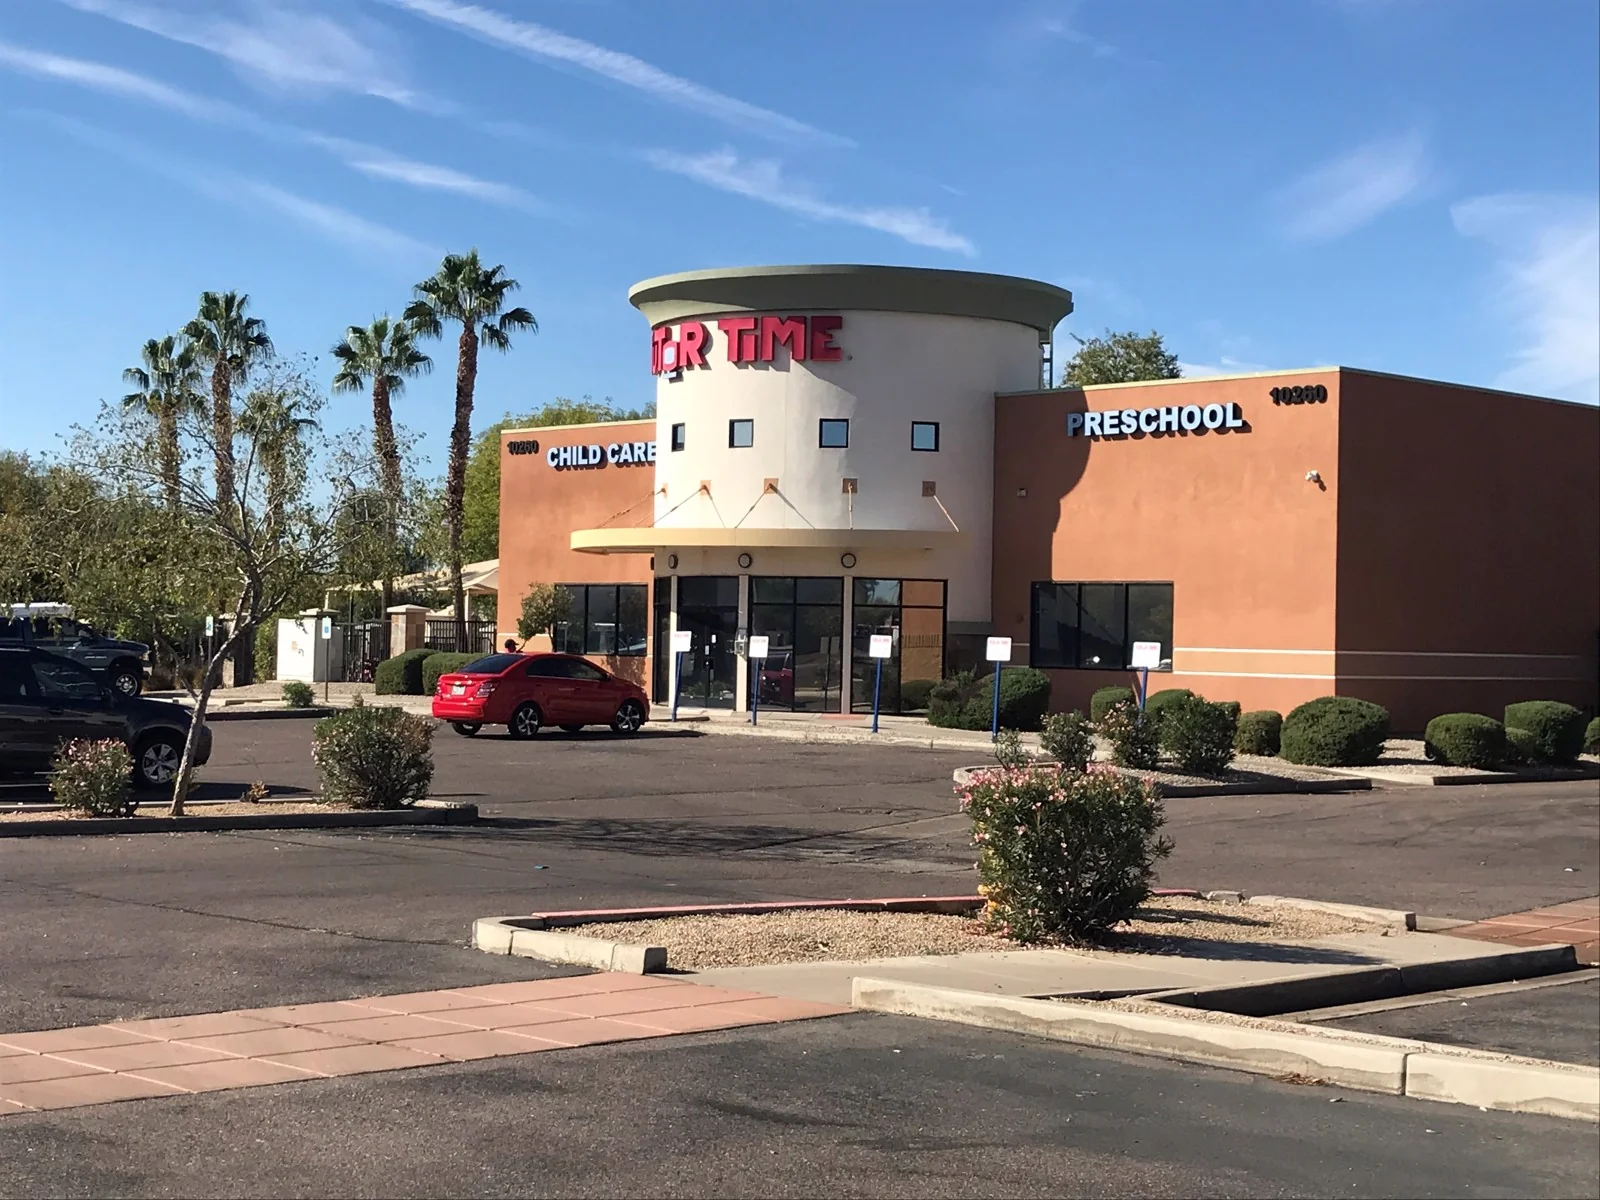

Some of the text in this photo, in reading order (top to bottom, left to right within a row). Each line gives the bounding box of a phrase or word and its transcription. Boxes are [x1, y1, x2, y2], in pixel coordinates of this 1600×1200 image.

[1270, 386, 1326, 404] 10260
[1067, 403, 1243, 437] PRESCHOOL
[508, 441, 538, 454] 10260
[547, 441, 656, 467] CHILD CARE
